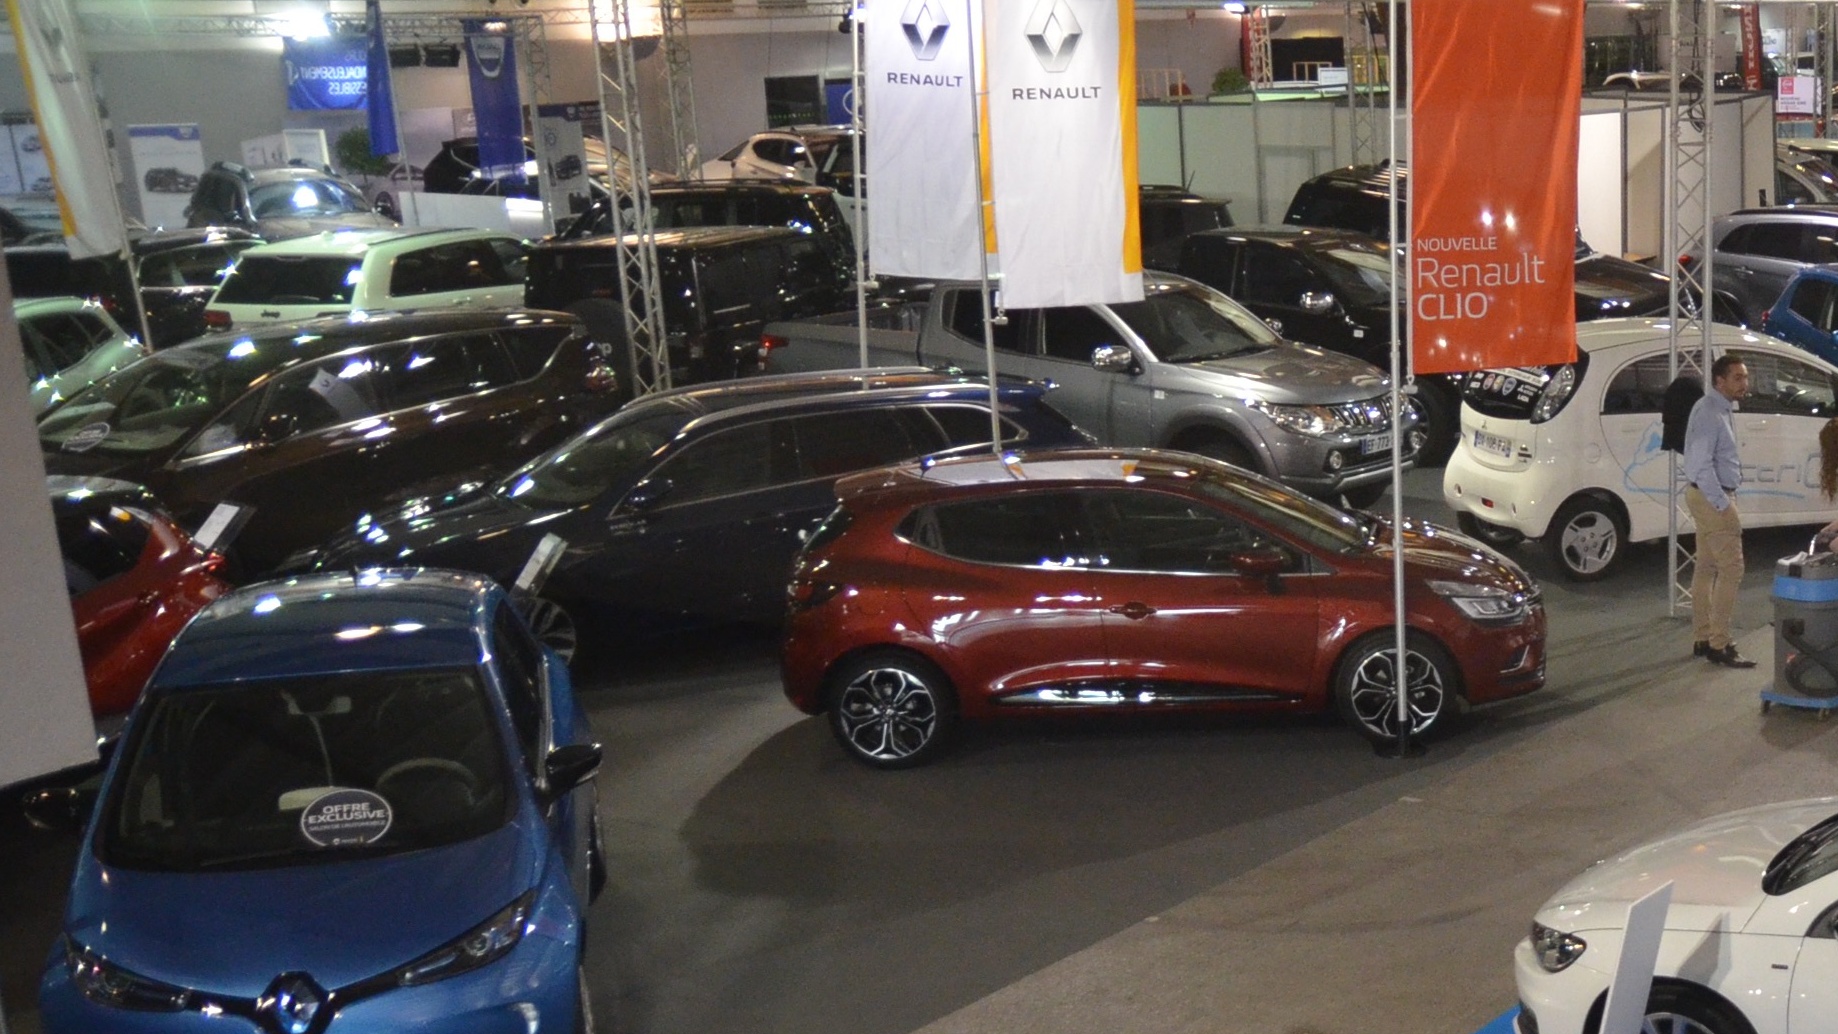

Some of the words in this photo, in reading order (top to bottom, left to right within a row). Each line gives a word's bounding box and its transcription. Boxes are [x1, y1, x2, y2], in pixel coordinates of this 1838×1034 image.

[887, 72, 963, 87] RENAULT
[1012, 86, 1101, 100] RENAULT
[1417, 237, 1497, 251] NOUVELLE
[1417, 252, 1545, 288] Renault
[1417, 292, 1488, 321] CLIO
[322, 802, 370, 814] OFFRE
[308, 810, 385, 824] EXCLUSIVE
